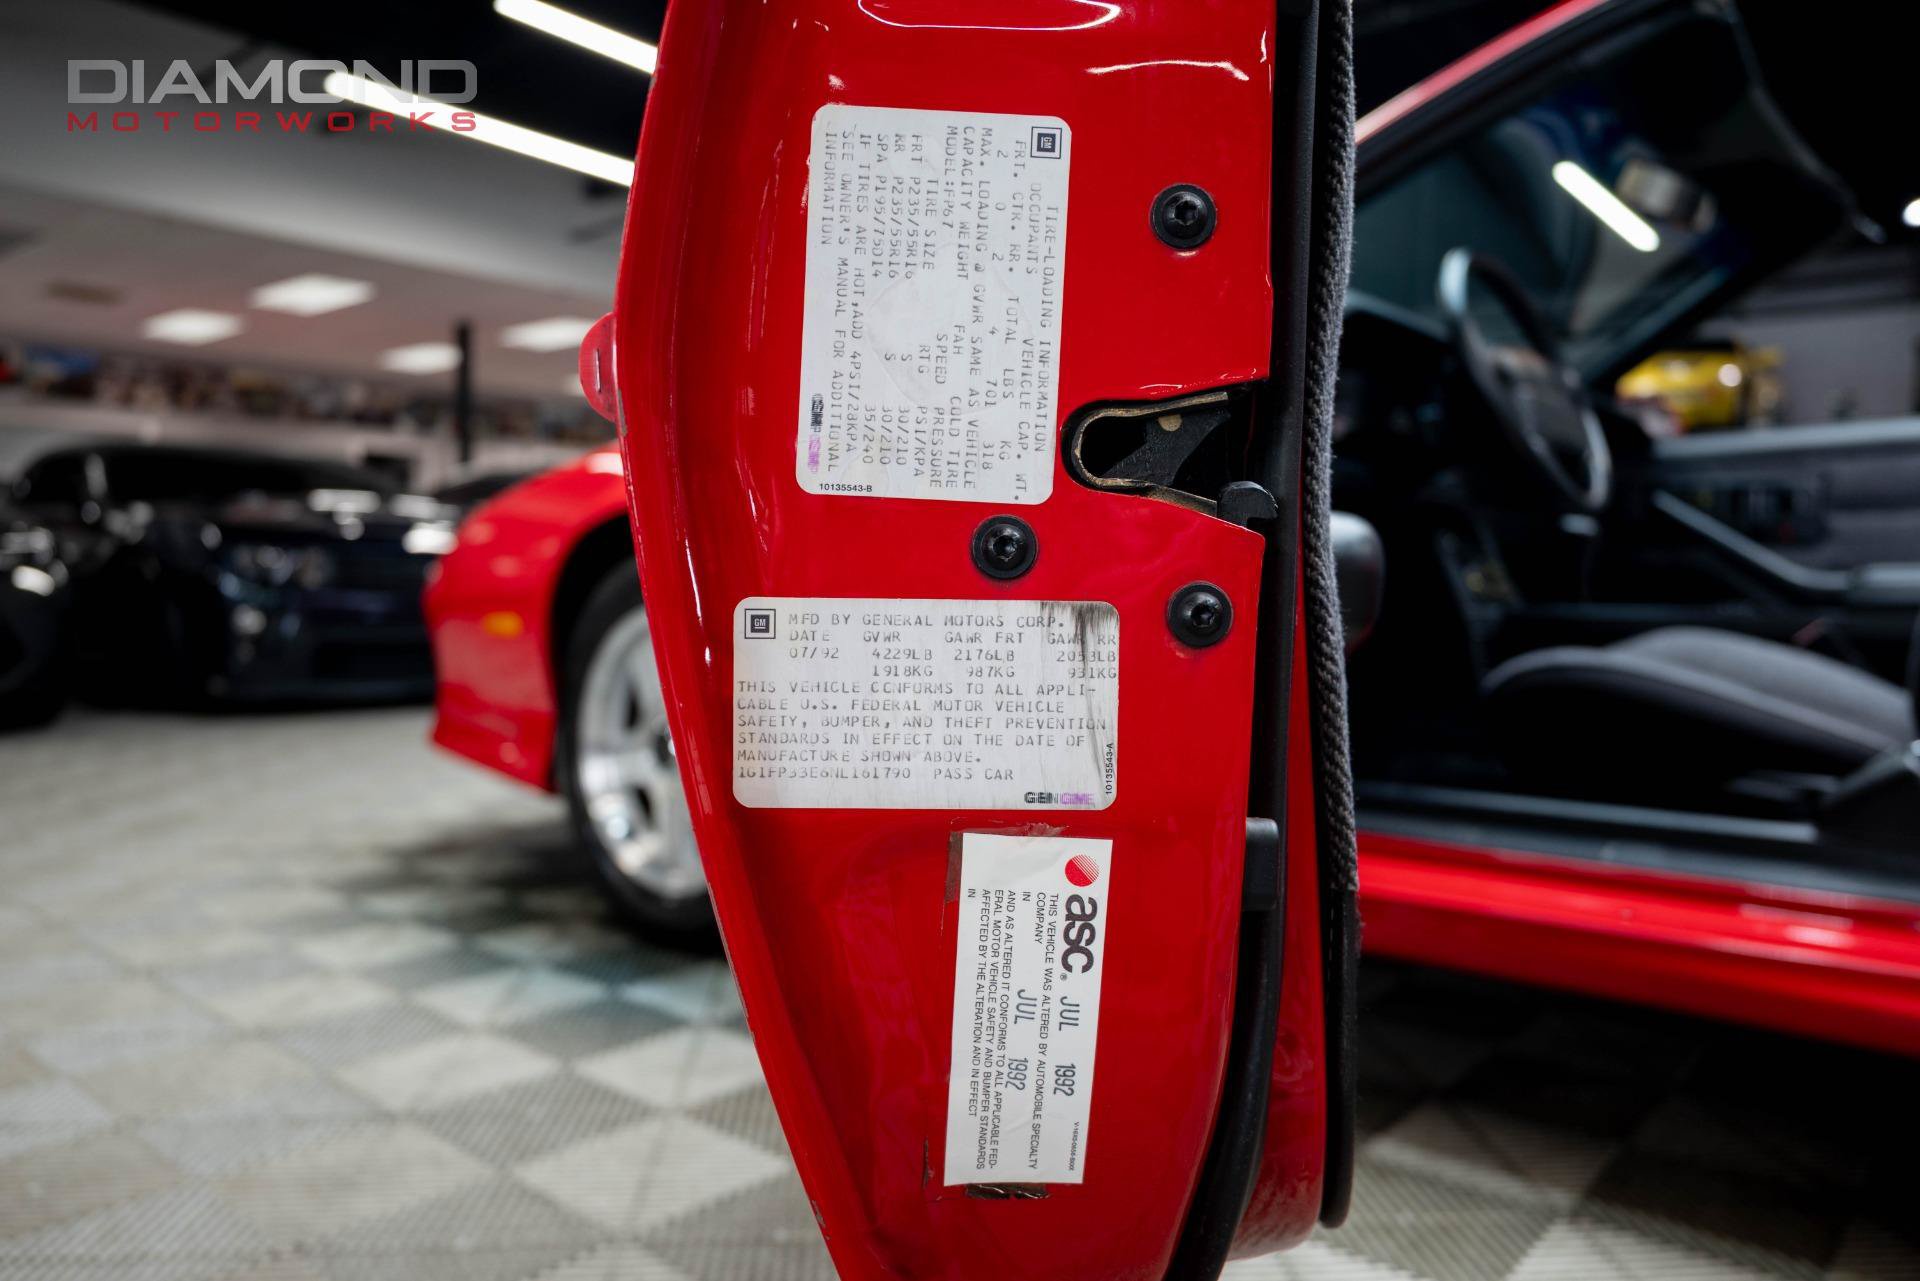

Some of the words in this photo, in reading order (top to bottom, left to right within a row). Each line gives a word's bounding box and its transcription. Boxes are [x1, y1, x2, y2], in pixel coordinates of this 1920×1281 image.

[840, 129, 854, 161] SEE
[859, 133, 872, 149] IF
[875, 132, 888, 163] SPA
[893, 132, 905, 153] RR
[910, 133, 923, 164] FRT
[979, 126, 993, 167] MAX.
[996, 148, 1008, 158] 2
[1042, 135, 1052, 149] GM
[959, 125, 975, 210] CAPACITY
[1012, 139, 1027, 178] FRT.
[820, 131, 837, 245] INFORMATION
[855, 162, 871, 213] TIRES
[924, 178, 939, 216] TIRE
[837, 172, 852, 245] OWNER'S
[974, 179, 990, 252] LOADING
[994, 201, 1006, 211] 0
[1010, 191, 1024, 231] CTR.
[853, 223, 867, 255] ARE
[887, 175, 904, 279] P235/55R16
[903, 176, 921, 279] P235/55R16
[1025, 183, 1041, 274] OCCUPANTS
[921, 228, 936, 269] SIZE
[956, 221, 970, 280] WEIGHT
[991, 251, 1004, 261] 2
[1007, 243, 1021, 272] RR.
[1039, 206, 1058, 328] TIRE-LOADING
[834, 256, 848, 317] MANUAL
[971, 283, 985, 323] GVWR
[988, 325, 999, 335] 4
[1003, 296, 1019, 344] TOTAL
[832, 328, 846, 358] FOR
[883, 351, 896, 361] S
[952, 324, 965, 355] FAH
[968, 335, 982, 375] SAME
[900, 353, 912, 362] S
[916, 344, 931, 374] RTG
[934, 332, 948, 384] SPEED
[1018, 337, 1034, 409] VEHICLE
[967, 387, 980, 408] AS
[983, 379, 998, 407] 701
[1001, 367, 1015, 399] LBS
[1033, 340, 1051, 452] INFORMATION
[827, 369, 844, 472] ADDITIONAL
[947, 395, 962, 437] COLD
[861, 403, 876, 464] 35/240
[912, 405, 928, 477] PSI/KPA
[929, 406, 945, 488] PRESSURE
[997, 439, 1011, 461] KG
[1015, 420, 1030, 459] CAP.
[944, 449, 960, 488] TIRE
[963, 418, 979, 488] VEHICLE
[981, 441, 995, 470] 318
[1013, 473, 1027, 501] WT.
[753, 618, 766, 628] GM
[788, 612, 820, 625] MFD
[831, 612, 851, 625] BY
[861, 613, 933, 626] GENERAL
[943, 614, 1004, 627] MOTORS
[1015, 614, 1064, 629] CORP.
[788, 628, 830, 642] DATE
[862, 630, 901, 643] GVWR
[994, 630, 1024, 644] FRT
[1096, 632, 1118, 645] RR
[736, 680, 776, 693] THIS
[788, 680, 860, 694] VEHICLE
[869, 680, 953, 694] CONFORMS
[966, 681, 984, 695] TO
[994, 682, 1023, 696] ALL
[1035, 683, 1096, 698] APPLI-
[736, 698, 787, 710] CABLE
[799, 698, 837, 710] U.S.
[850, 698, 921, 711] FEDERAL
[932, 698, 983, 712] MOTOR
[994, 699, 1064, 713] VEHICLE
[737, 713, 807, 729] SAFETY,
[820, 714, 890, 729] BUMPER,
[901, 715, 933, 728] AND
[944, 715, 992, 729] THEFT
[1004, 716, 1106, 732] PREVENTION
[737, 731, 830, 744] STANDARDS
[842, 732, 859, 745] IN
[871, 732, 933, 746] EFFECT
[942, 733, 962, 746] ON
[973, 732, 1003, 746] THE
[1015, 733, 1055, 747] DATE
[1065, 734, 1085, 747] OF
[736, 748, 850, 762] MANUFACTURE
[859, 749, 911, 762] SHOWN
[922, 750, 981, 763] ABOVE.
[1104, 741, 1114, 795] 10135543-A
[933, 767, 973, 780] PASS
[983, 767, 1013, 780] CAR
[967, 887, 976, 898] IN
[992, 889, 1004, 916] ERAL
[1005, 889, 1016, 912] AND
[1021, 890, 1031, 902] IN
[1047, 892, 1059, 916] THIS
[978, 888, 991, 942] AFFECTED
[1004, 914, 1014, 930] AS
[1033, 891, 1046, 944] COMPANY
[977, 944, 988, 958] BY
[990, 919, 1002, 958] MOTOR
[1001, 932, 1013, 979] ALTERED
[1044, 920, 1056, 964] VEHICLE
[975, 960, 987, 981] THE
[987, 960, 999, 1003] VEHICLE
[1000, 981, 1010, 991] IT
[1042, 967, 1053, 991] WAS
[972, 982, 985, 1043] ALTERATION
[996, 993, 1010, 1051] CONFORMS
[1013, 988, 1037, 1025] JUL
[1038, 993, 1051, 1039] ALTERED
[1057, 995, 1080, 1031] JUL
[985, 1006, 996, 1044] SAFETY
[971, 1044, 981, 1066] AND
[983, 1046, 993, 1068] AND
[994, 1053, 1006, 1068] TO
[1037, 1042, 1048, 1056] BY
[970, 1067, 980, 1078] IN
[993, 1069, 1004, 1088] ALL
[1003, 1056, 1029, 1091] 1992
[1032, 1058, 1046, 1120] AUTOMOBILE
[1052, 1062, 1076, 1096] 1992
[967, 1079, 979, 1117] EFFECT
[980, 1070, 992, 1112] BUMPER
[989, 1090, 1002, 1146] APPLICABLE
[975, 1114, 989, 1170] STANDARDS
[987, 1147, 998, 1169] FED-
[1027, 1122, 1041, 1169] SPECIALTY
